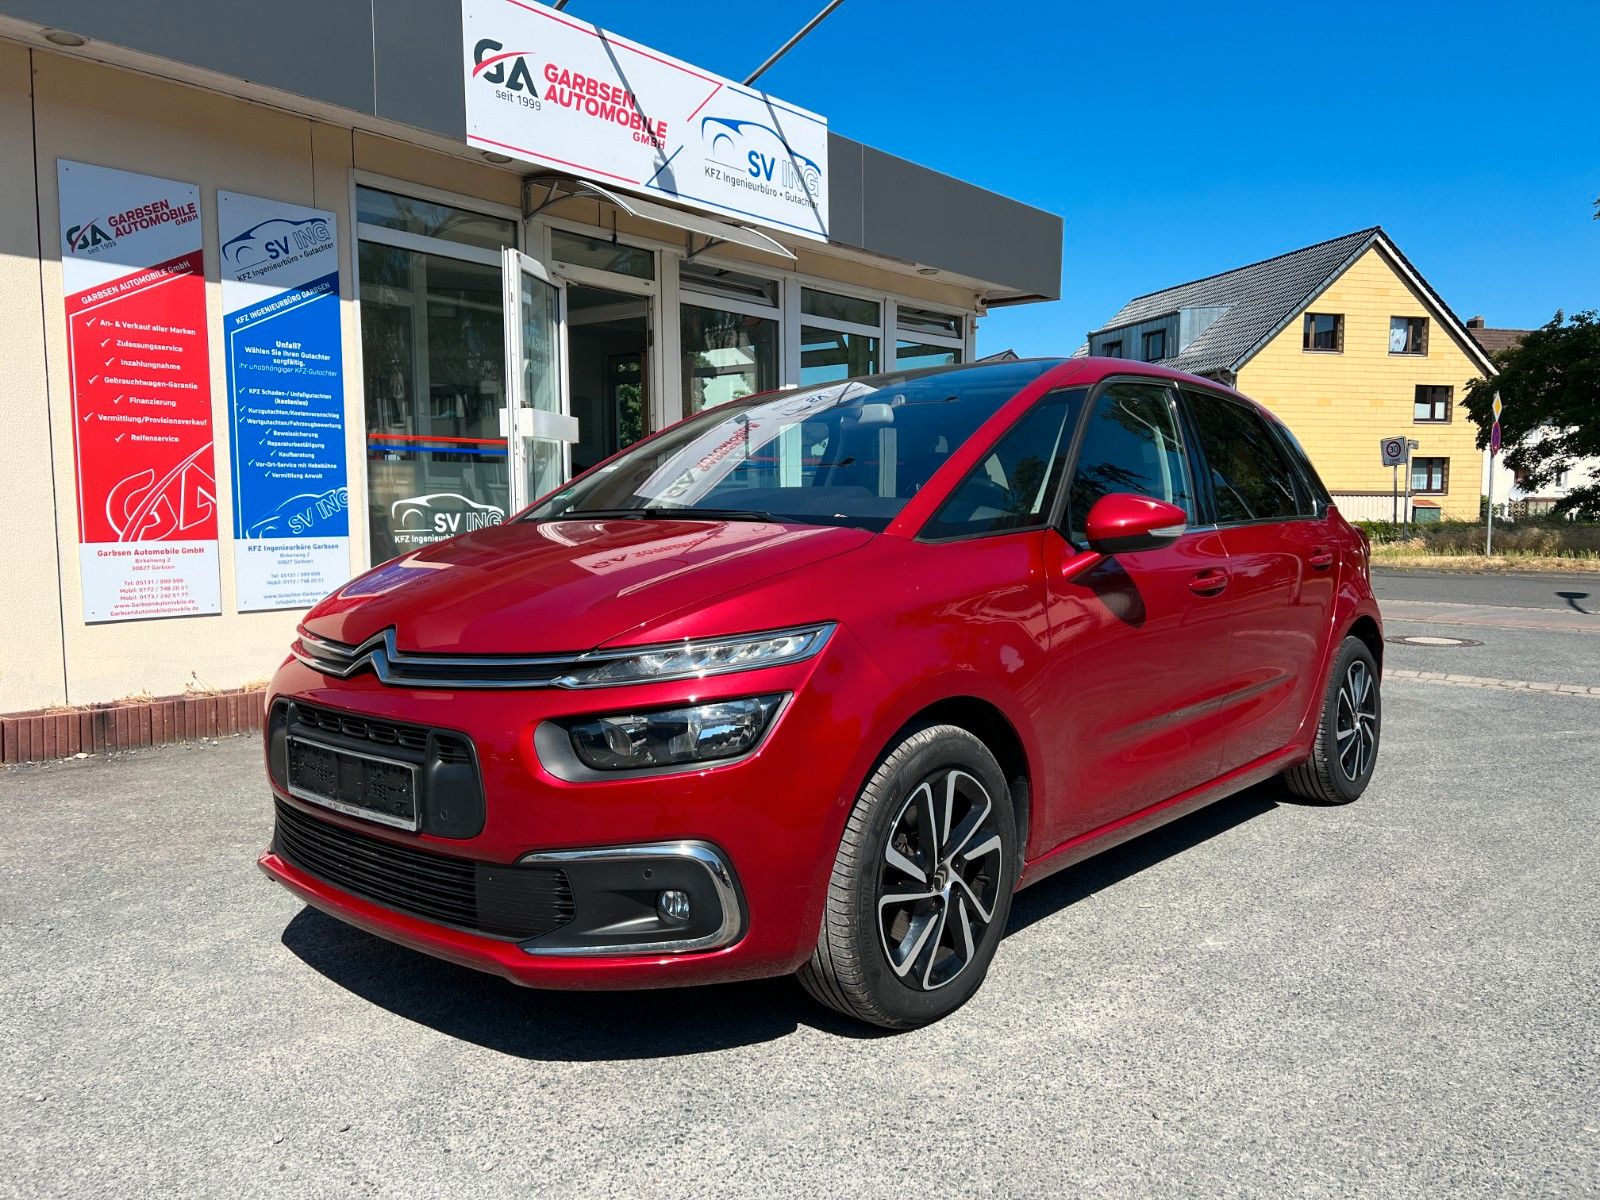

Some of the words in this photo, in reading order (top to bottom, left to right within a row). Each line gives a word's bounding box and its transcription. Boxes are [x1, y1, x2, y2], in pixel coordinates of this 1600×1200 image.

[544, 63, 636, 110] GARBSEN
[495, 89, 514, 103] seit
[516, 95, 541, 111] 1999
[544, 85, 668, 139] AUTOMOBILE
[632, 131, 666, 150] GMBH
[747, 149, 776, 182] SV
[781, 159, 819, 197] ING
[704, 166, 721, 181] KFZ
[723, 172, 778, 197] Ingenieurbüro
[784, 191, 819, 209] Gutachter
[107, 199, 169, 227] GARBSEN
[115, 203, 197, 238] AUTOMOBILE
[175, 213, 199, 226] GMBH
[87, 246, 100, 255] seit
[100, 241, 117, 251] 1999
[264, 236, 290, 260] SV
[292, 222, 331, 250] ING
[237, 271, 252, 282] KFZ
[253, 255, 299, 277] Ingenieurbüro
[303, 242, 335, 258] Gutachter
[81, 286, 119, 304] GARBSEN
[120, 269, 168, 292] AUTOMOBILE
[167, 260, 191, 273] GmbH
[235, 314, 250, 325] KFZ
[250, 295, 302, 319] INGENIEURBÜRO
[301, 282, 331, 299] GARBSEN
[100, 319, 114, 328] An-
[115, 320, 121, 328] &
[122, 321, 151, 330] Verkauf
[152, 324, 168, 332] aller
[170, 326, 196, 336] Marken
[116, 339, 183, 352] Zulassungsservice
[245, 346, 270, 355] Wählen
[283, 350, 299, 358] Ihren
[301, 351, 331, 361] Gutachter
[275, 341, 301, 350] Unfall?
[120, 359, 181, 371] Inzahlungnahme
[103, 376, 198, 390] Gebrauchtwagen-Garantie
[129, 396, 177, 407] Finanzierung
[97, 414, 207, 426] Vermittlung/Provisionsverkauf
[130, 434, 179, 443] Reifenservice
[1390, 445, 1398, 454] 30
[288, 507, 314, 535] SV
[434, 513, 461, 532] SV
[264, 544, 311, 552] Ingenieurbüro
[394, 535, 410, 544] KFZ
[134, 548, 179, 557] Automobile
